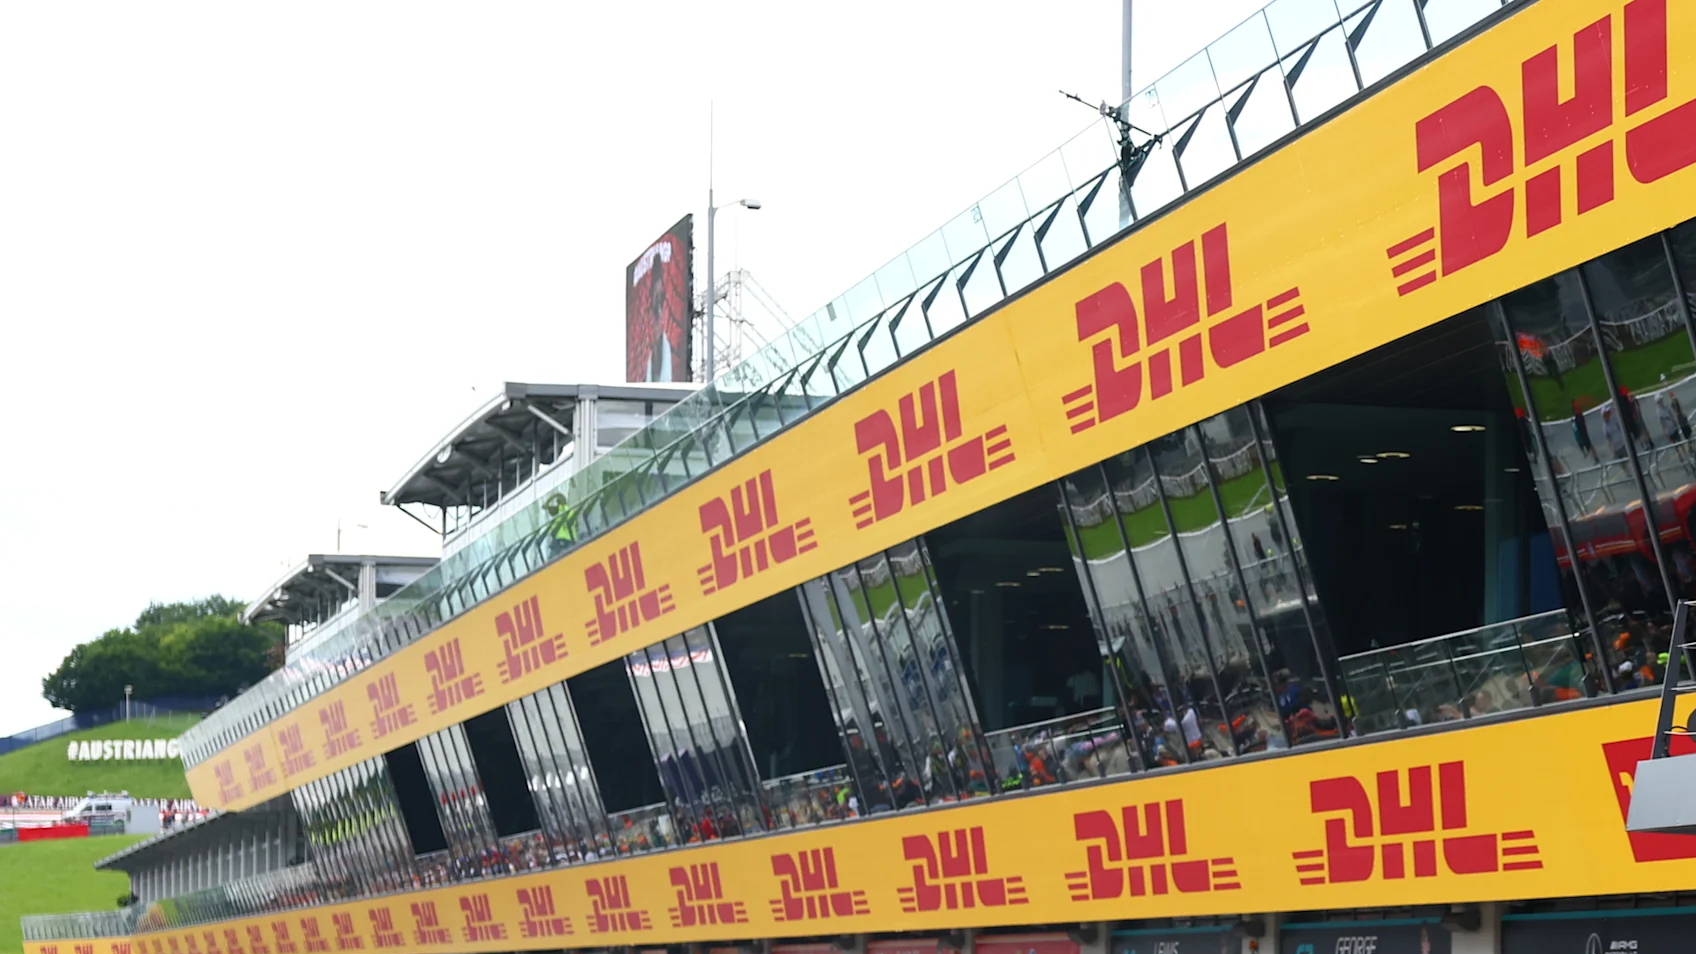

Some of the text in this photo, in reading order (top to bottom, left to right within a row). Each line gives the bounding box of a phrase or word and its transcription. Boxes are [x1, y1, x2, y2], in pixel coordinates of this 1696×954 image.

[1075, 221, 1265, 423] DHL
[854, 369, 986, 521] DHL
[699, 469, 796, 590] DHL
[584, 541, 662, 644] DHL
[424, 638, 476, 714] DHL
[495, 595, 555, 682] DHL
[367, 672, 408, 736] DHL
[67, 738, 180, 761] #AUSTRIANG
[1073, 798, 1211, 900] DHL
[1310, 760, 1498, 884] DHL
[585, 875, 642, 934] DHL
[669, 862, 735, 927] DHL
[770, 847, 853, 921] DHL
[903, 826, 1006, 912] DHL
[411, 901, 447, 945] DHL
[459, 894, 501, 942] DHL
[517, 885, 565, 938] DHL
